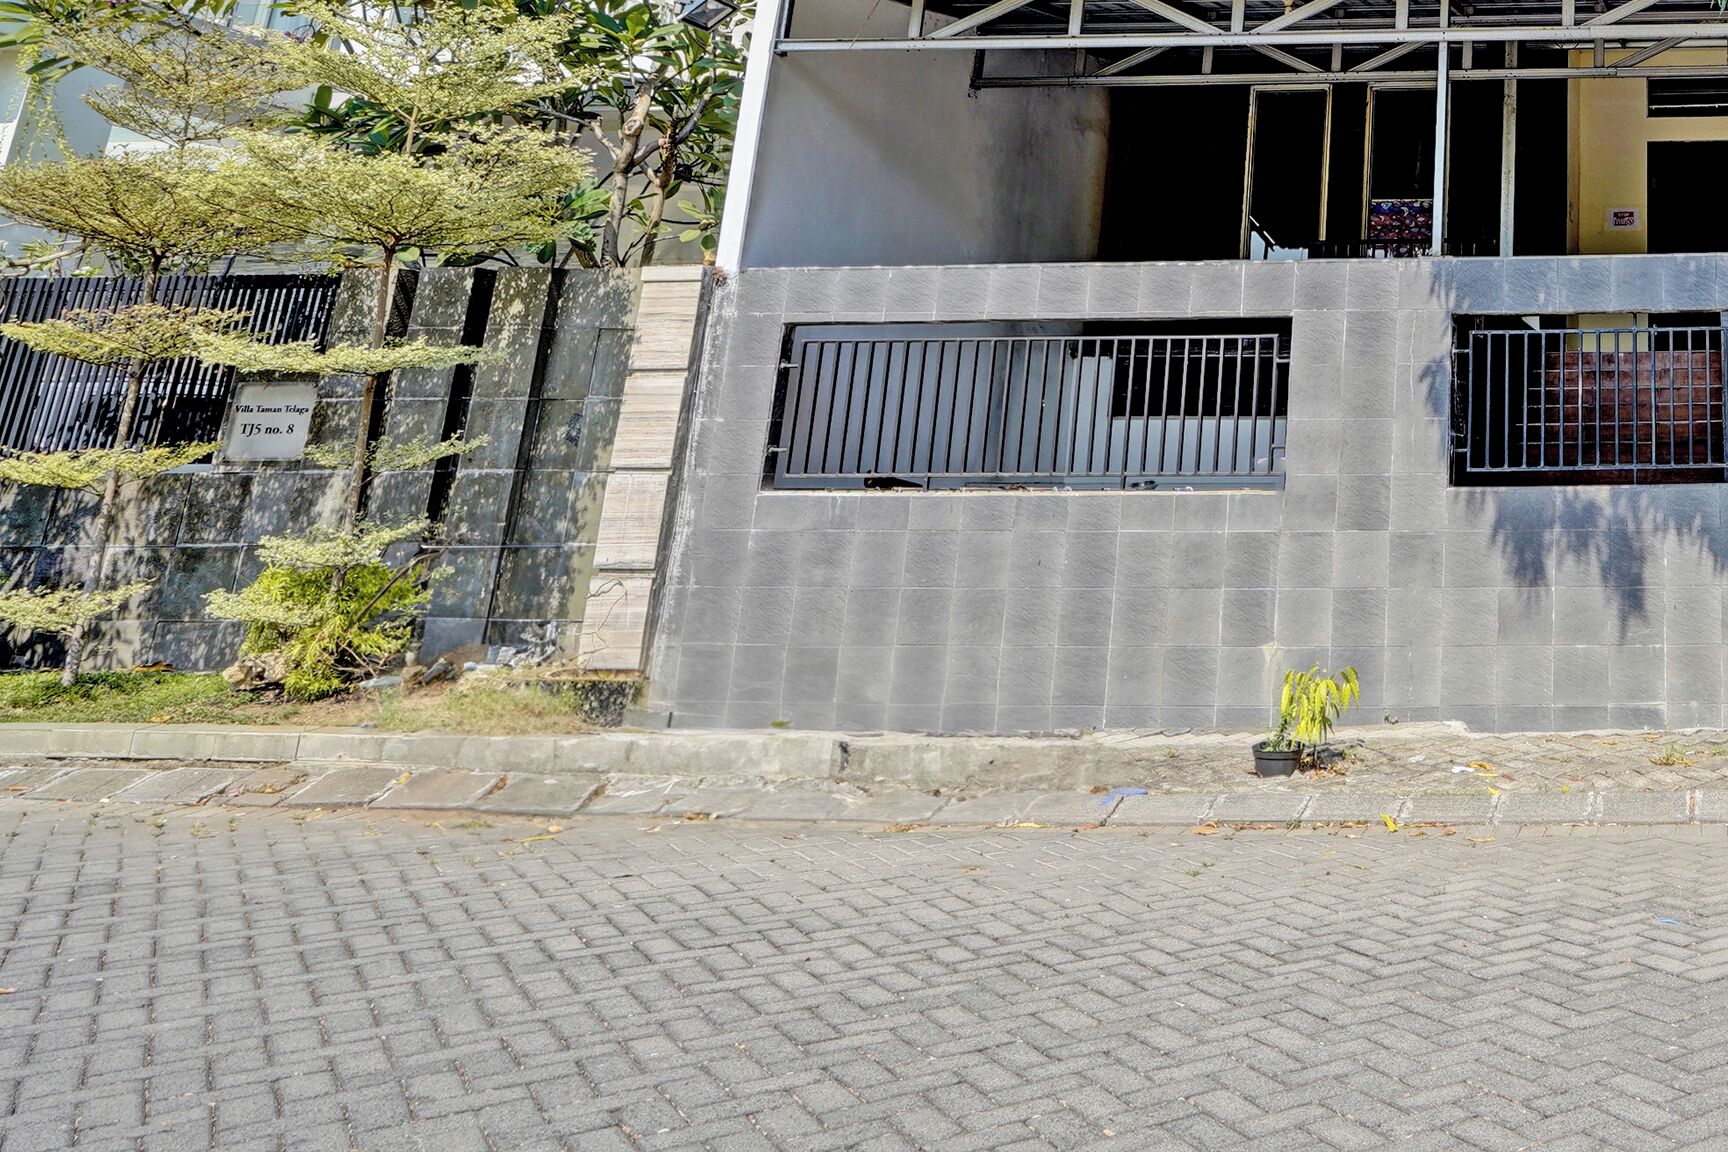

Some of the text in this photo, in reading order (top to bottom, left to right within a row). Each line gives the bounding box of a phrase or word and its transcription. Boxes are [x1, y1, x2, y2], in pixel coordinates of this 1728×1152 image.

[235, 405, 309, 415] Villa Taman Telaga
[240, 423, 294, 437] TJ5 no. 8
